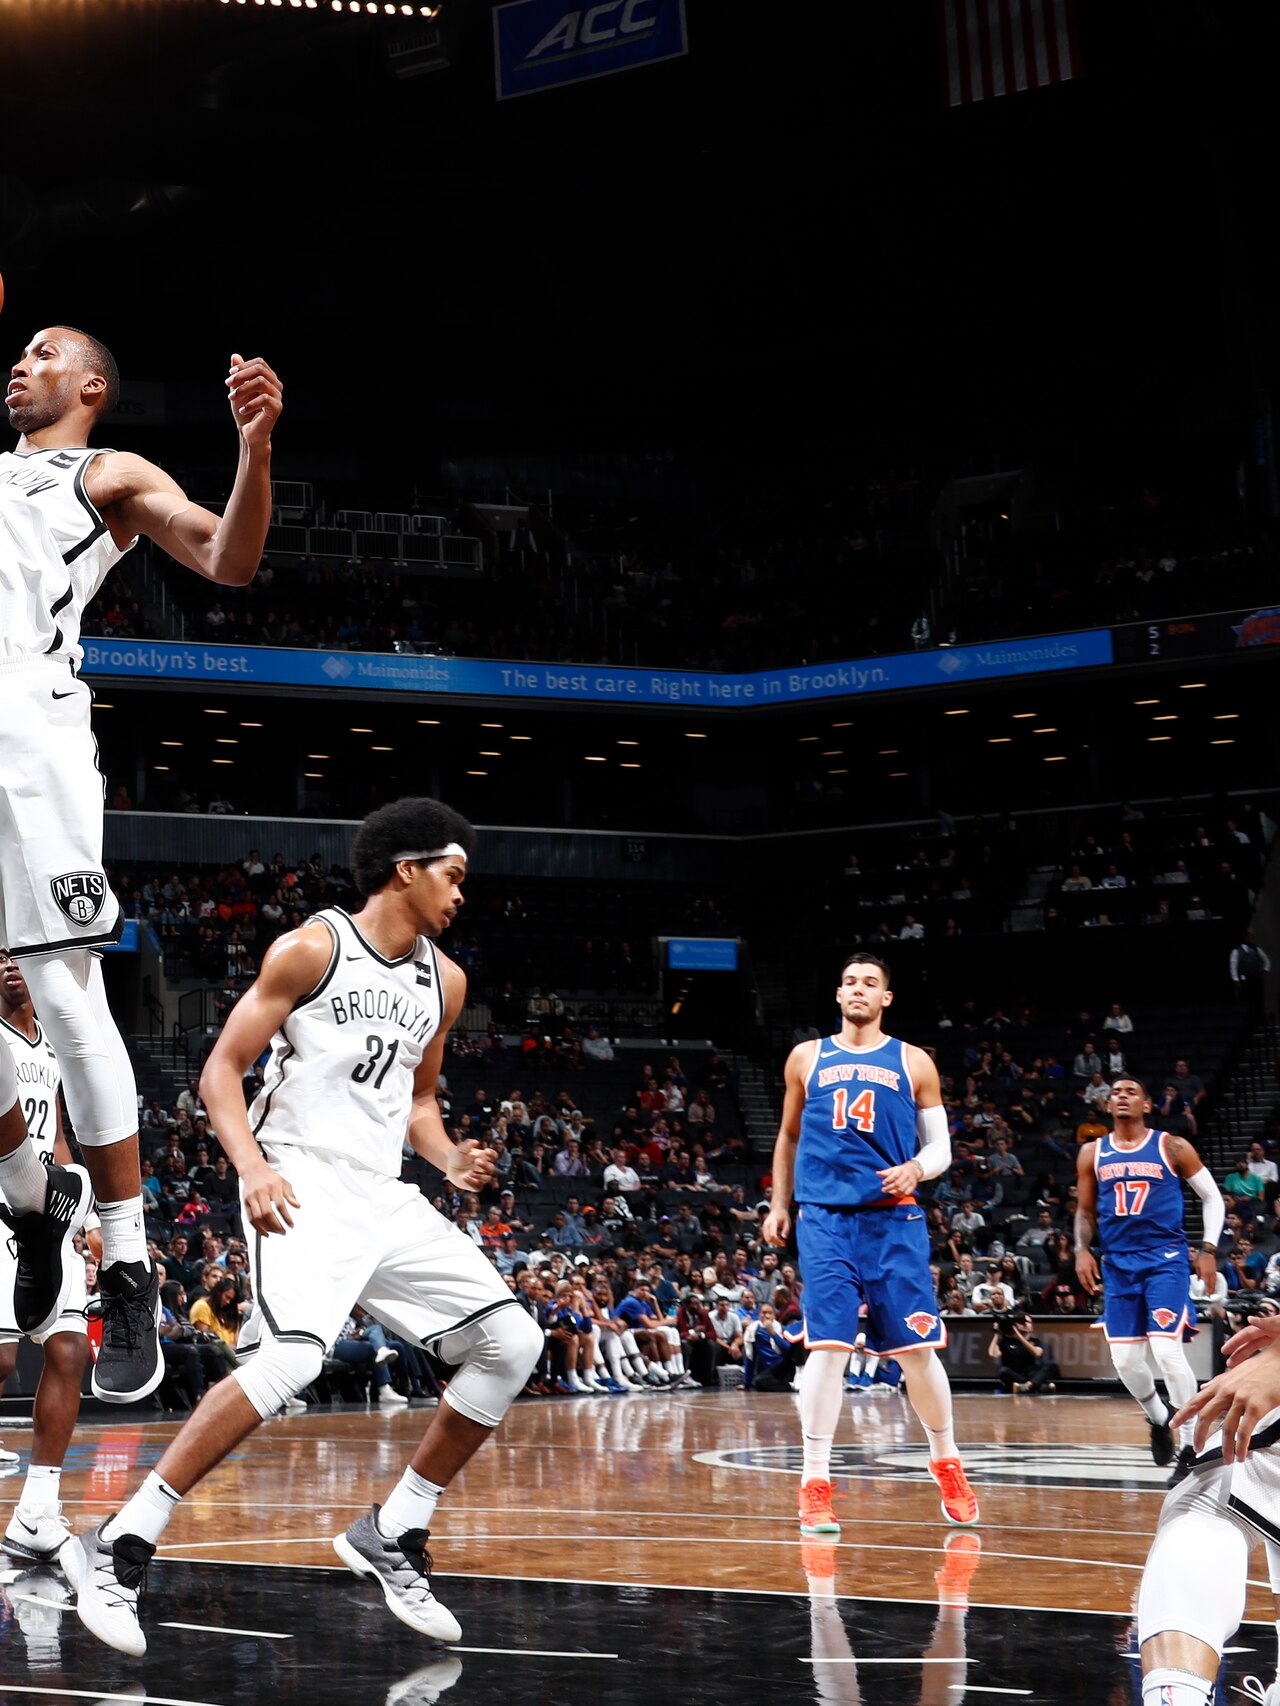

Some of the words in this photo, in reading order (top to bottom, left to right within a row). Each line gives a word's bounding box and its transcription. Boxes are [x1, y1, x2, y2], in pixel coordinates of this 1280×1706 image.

[524, 0, 656, 59] ACC
[87, 645, 197, 673] Brooklyn's
[203, 650, 255, 673] best.
[976, 641, 1079, 667] Maimonides
[357, 661, 450, 682] Maimonides
[499, 668, 537, 690] The
[545, 670, 589, 692] best
[593, 676, 643, 694] care.
[650, 676, 703, 701] Right
[708, 679, 755, 699] here
[762, 676, 783, 697] in
[788, 665, 890, 694] Brooklyn.
[55, 875, 104, 901] NETS
[331, 989, 433, 1044] BROOKLYN
[16, 1062, 59, 1090] ROOKLY
[351, 1034, 399, 1090] 31
[818, 1064, 857, 1088] NEW
[856, 1064, 901, 1092] YORK
[24, 1097, 50, 1140] 22
[832, 1087, 876, 1133] 14
[1098, 1162, 1128, 1182] NEW
[1127, 1161, 1164, 1180] YORK
[1113, 1180, 1150, 1217] 17
